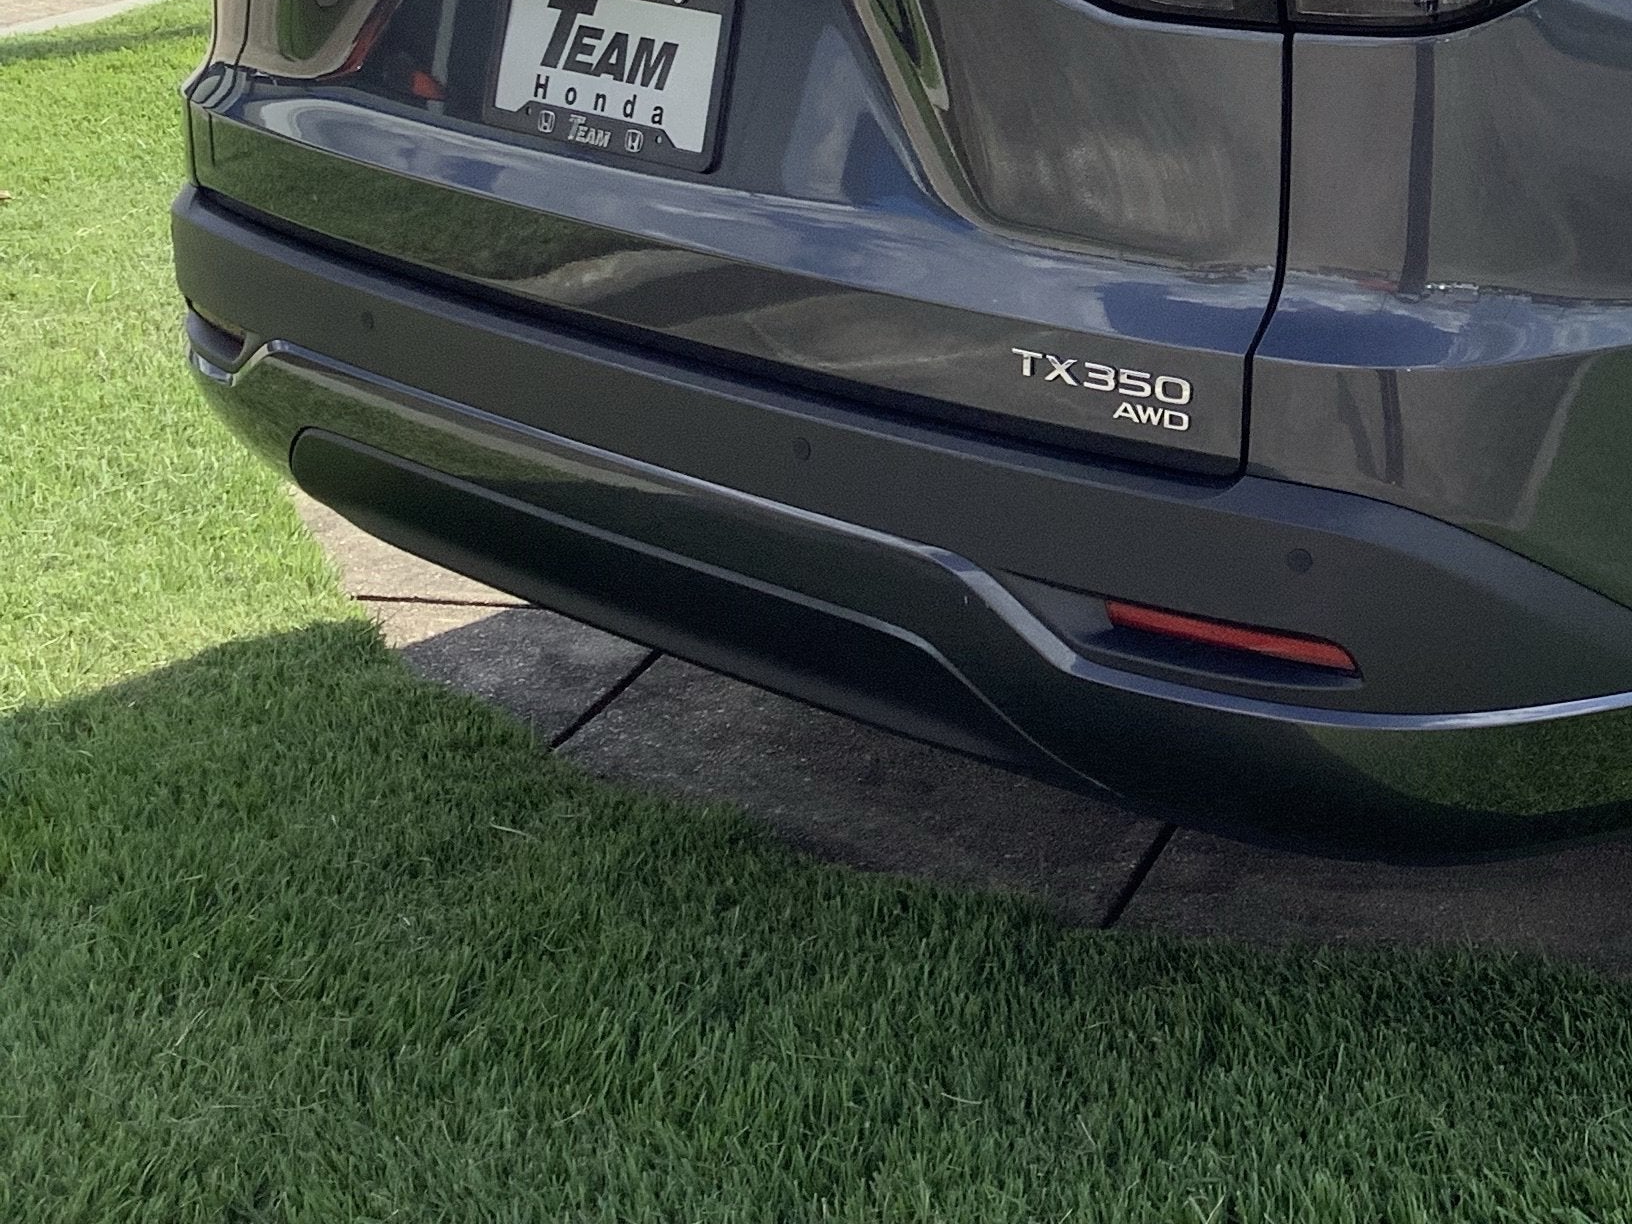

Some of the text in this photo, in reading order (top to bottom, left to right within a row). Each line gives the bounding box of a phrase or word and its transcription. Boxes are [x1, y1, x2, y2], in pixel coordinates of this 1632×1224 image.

[533, 74, 664, 125] Honda
[567, 114, 612, 148] TEAM
[1011, 347, 1192, 405] TX350
[1113, 401, 1190, 432] AWD
